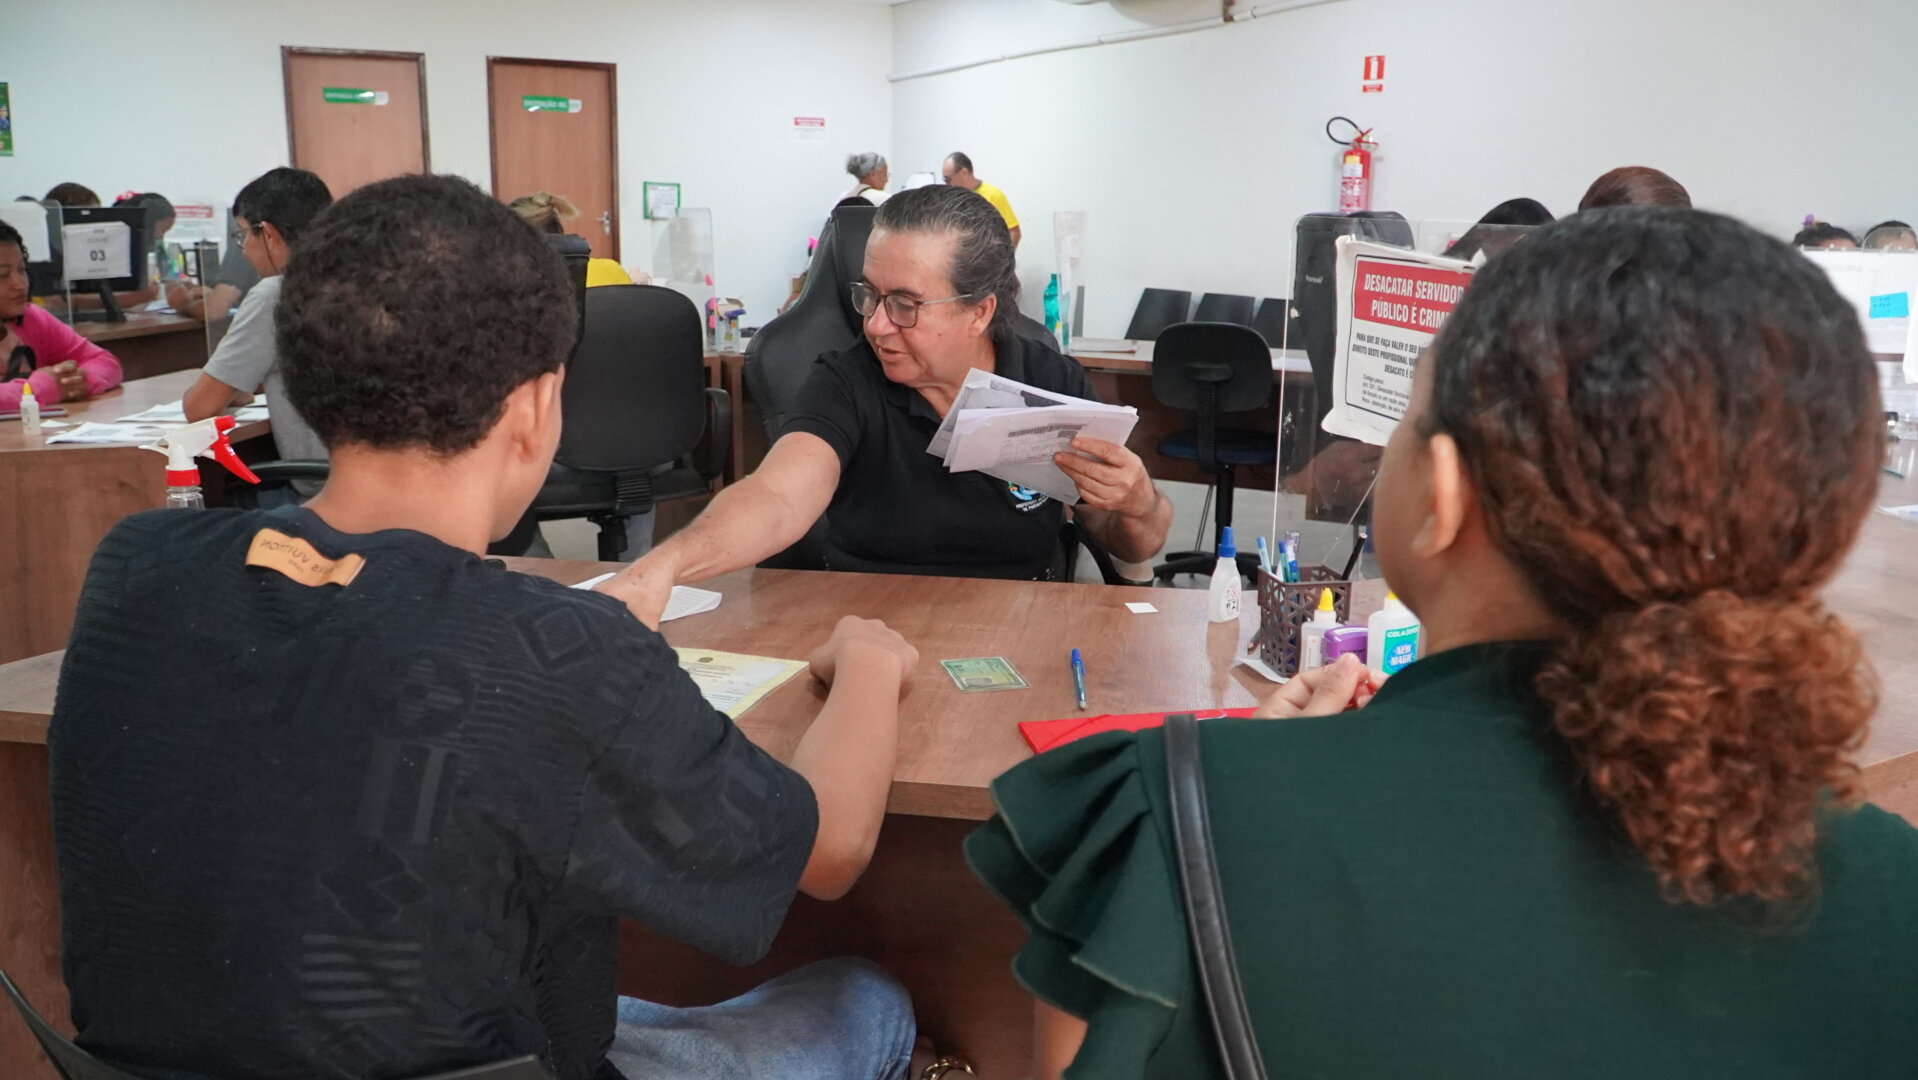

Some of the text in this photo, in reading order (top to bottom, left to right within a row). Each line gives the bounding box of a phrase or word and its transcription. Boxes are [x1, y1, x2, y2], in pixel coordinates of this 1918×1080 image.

[90, 250, 106, 261] 03
[1364, 273, 1413, 297] DESACATAR
[1371, 296, 1409, 323] PÚBLICO
[1411, 301, 1418, 324] É
[1356, 332, 1366, 342] PARA
[1366, 335, 1375, 344] QUE
[1375, 336, 1380, 345] SE
[1380, 337, 1391, 348] FAÇA
[1391, 340, 1404, 350] VALER
[1404, 343, 1408, 352] O
[1408, 344, 1418, 354] SEU
[1352, 344, 1367, 355] DIREITO
[1380, 350, 1408, 365] PROFISSIONAL
[1384, 364, 1406, 377] DESACATO
